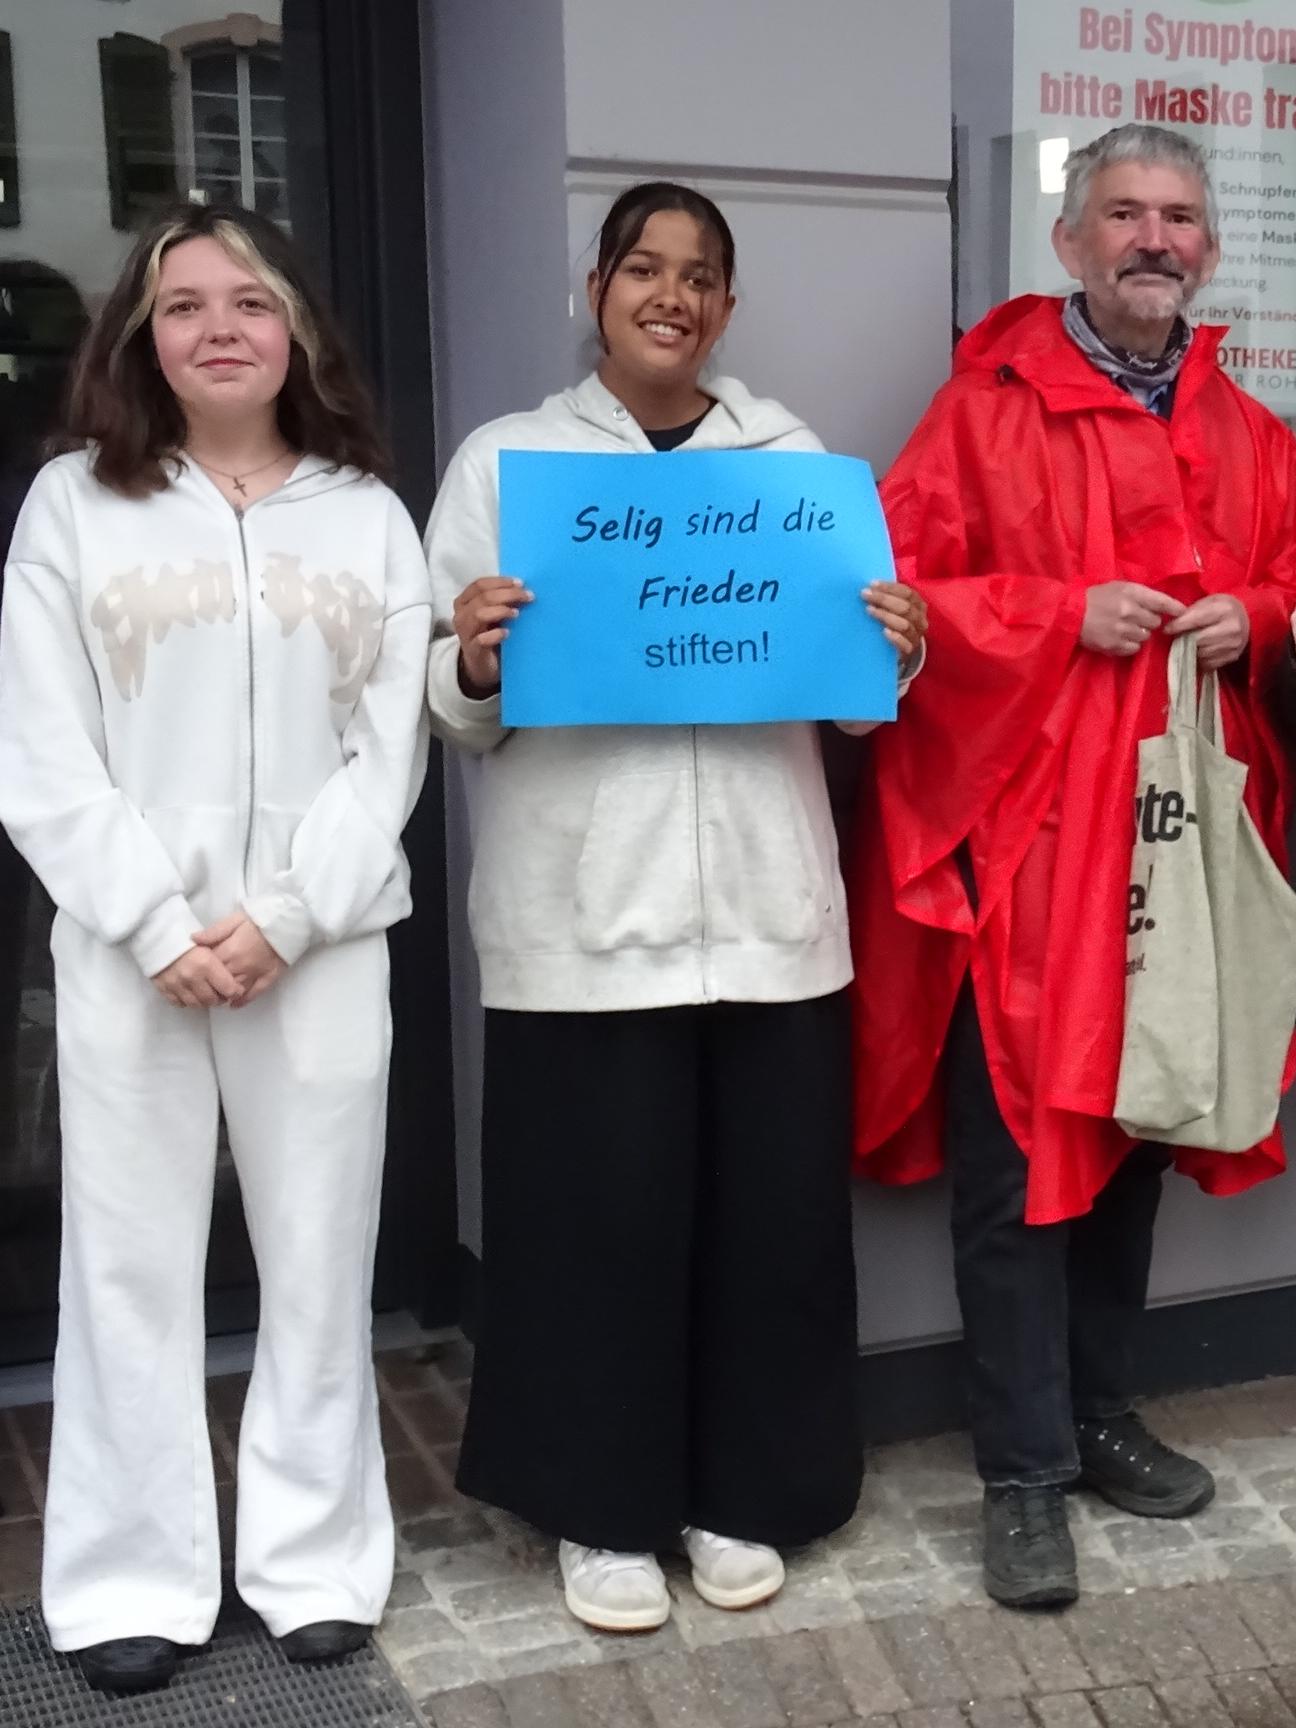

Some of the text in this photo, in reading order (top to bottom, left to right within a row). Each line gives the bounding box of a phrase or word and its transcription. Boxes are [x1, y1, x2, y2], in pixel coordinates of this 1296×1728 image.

[1079, 7, 1133, 53] Bei
[1040, 72, 1123, 119] bitte
[1134, 79, 1252, 127] Maske
[1218, 208, 1296, 222] ymptome
[1227, 230, 1258, 243] eine
[1220, 251, 1245, 265] hre
[1187, 305, 1206, 319] ür
[1208, 305, 1229, 319] Ihr
[571, 497, 836, 548] Selig sind die
[638, 569, 779, 611] Frieden
[645, 631, 770, 668] stiften!
